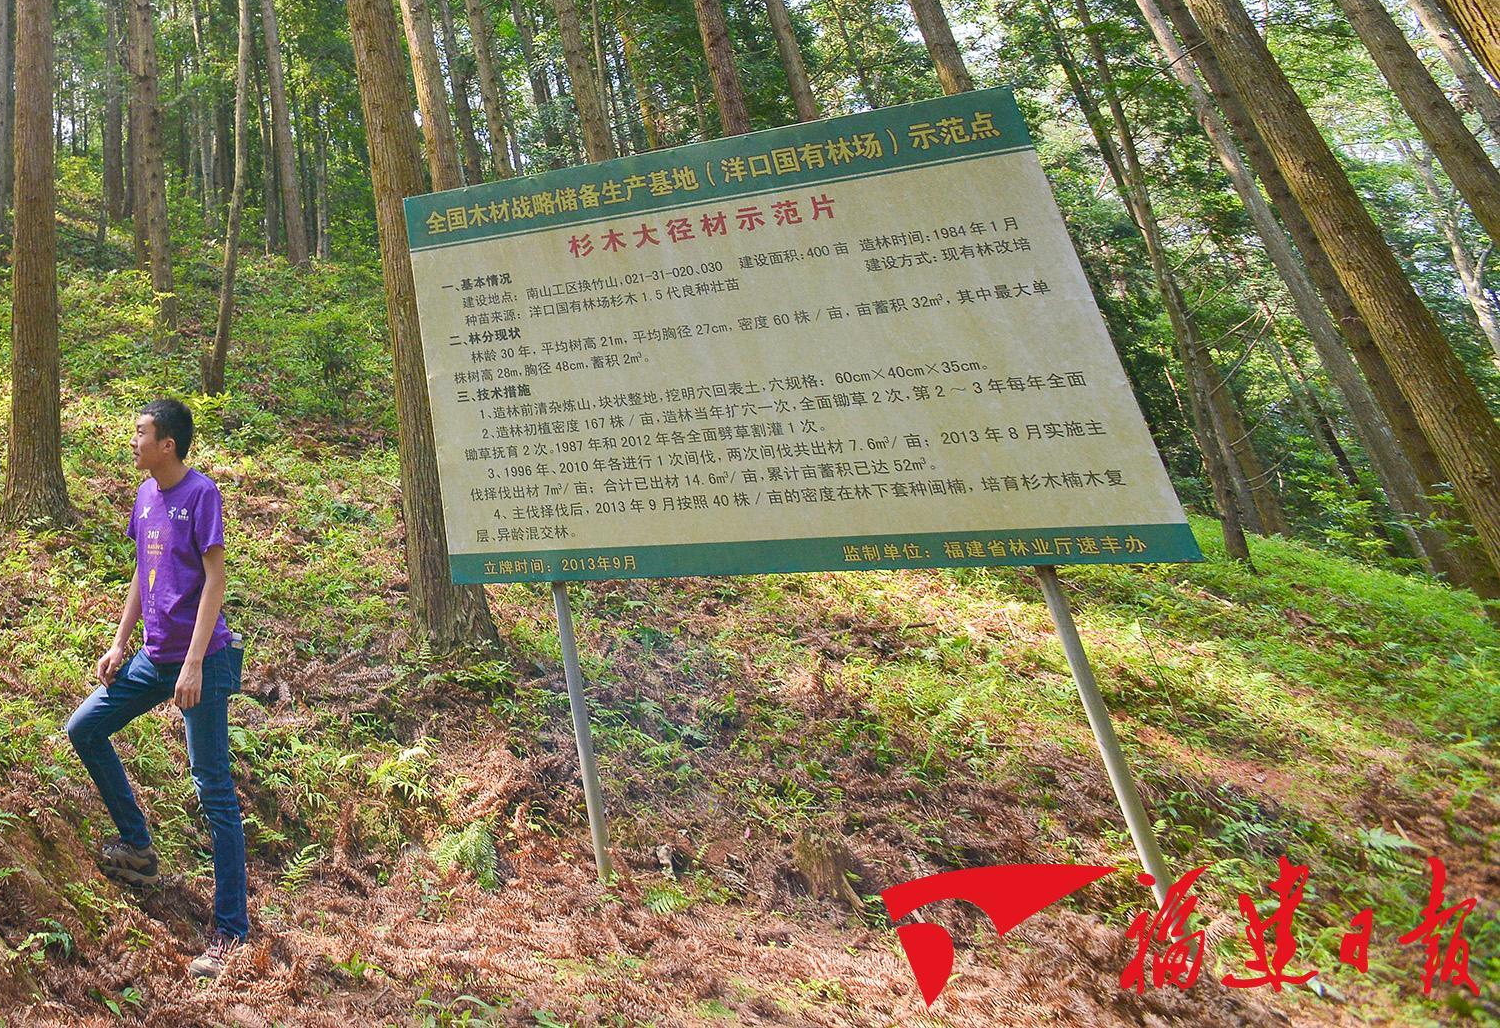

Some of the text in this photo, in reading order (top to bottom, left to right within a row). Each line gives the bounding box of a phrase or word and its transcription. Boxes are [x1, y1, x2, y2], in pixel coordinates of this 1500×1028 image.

[569, 193, 837, 259] 杉木大径材示范片
[441, 272, 513, 292] 一、基本情况
[449, 326, 522, 347] 二、林分现状
[456, 383, 532, 403] 三、技术措施
[147, 530, 160, 539] 2017
[476, 524, 576, 543] 层、异龄混交林。
